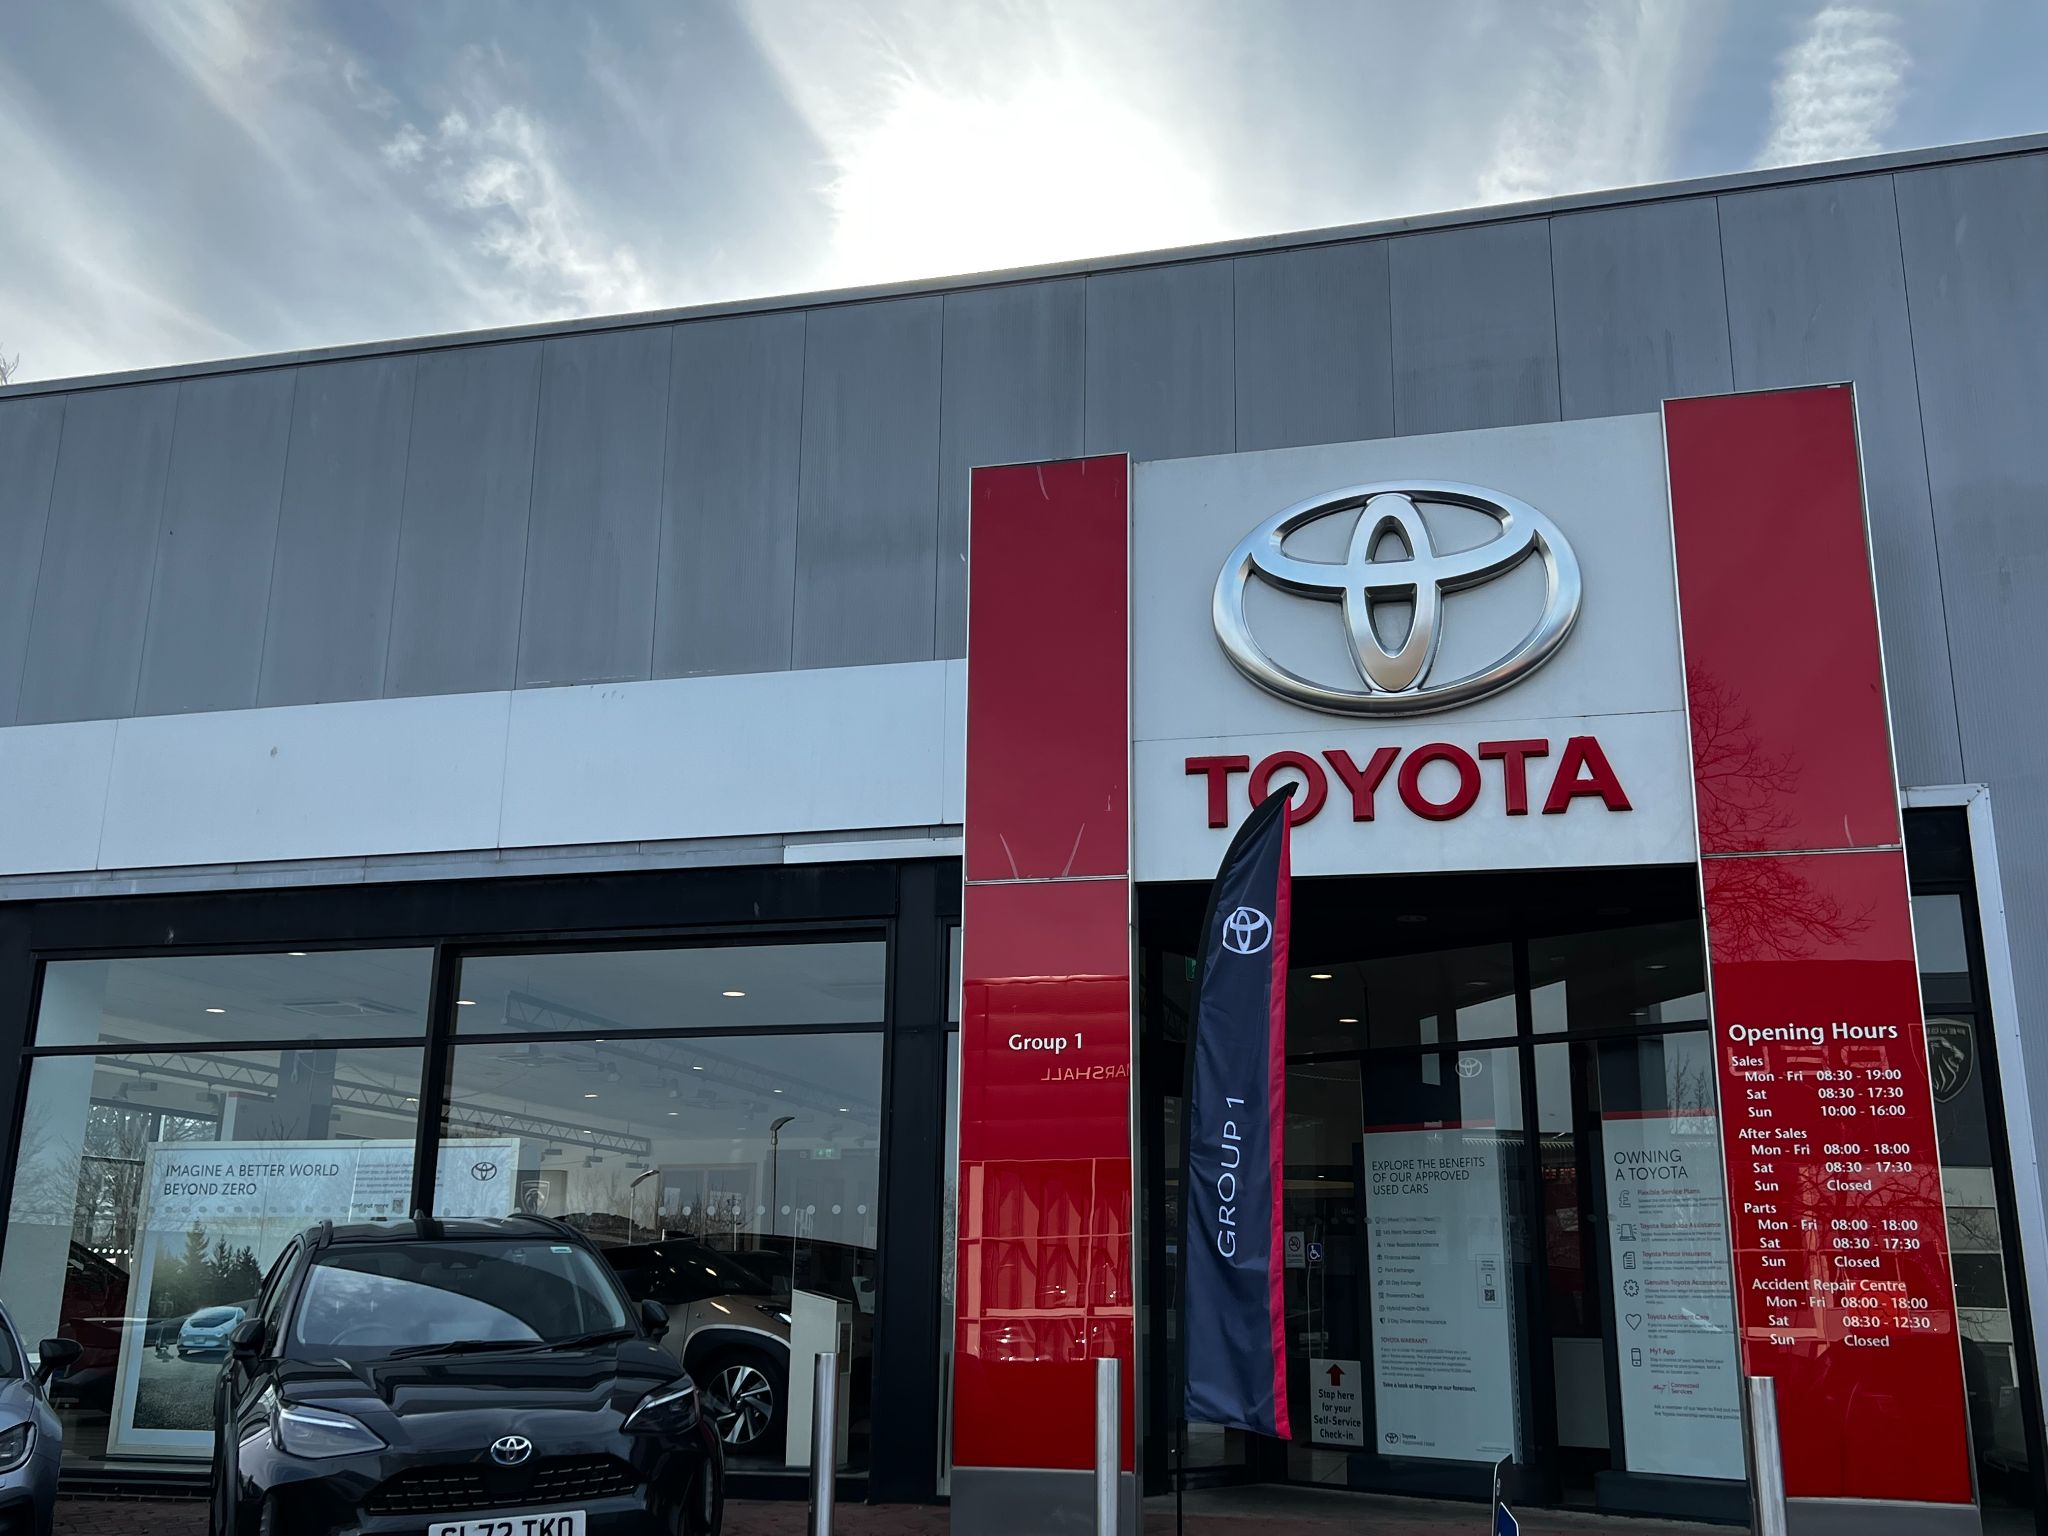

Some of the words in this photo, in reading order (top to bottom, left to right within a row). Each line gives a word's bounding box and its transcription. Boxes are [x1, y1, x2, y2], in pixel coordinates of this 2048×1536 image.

[1185, 736, 1632, 828] TOYOTA
[1728, 1023, 1825, 1045] Opening
[1832, 1023, 1898, 1039] Hours
[1008, 1034, 1067, 1054] Group
[1075, 1033, 1082, 1049] 1
[1731, 1056, 1764, 1067] Sales
[1745, 1071, 1775, 1082] Mon
[1787, 1071, 1804, 1082] Fri
[1816, 1070, 1853, 1081] 08:30
[1866, 1069, 1902, 1080] 19:00
[1746, 1089, 1767, 1100] Sat
[1818, 1088, 1855, 1099] 08:30
[1867, 1087, 1904, 1099] 17:30
[1226, 1097, 1245, 1108] 1
[1748, 1107, 1772, 1118] Sun
[1820, 1106, 1857, 1117] 10:00
[1870, 1105, 1906, 1116] 16:00
[1738, 1128, 1771, 1139] After
[1775, 1128, 1808, 1139] Sales
[1751, 1144, 1782, 1155] Mon
[1794, 1144, 1811, 1155] Fri
[1824, 1144, 1860, 1155] 08:00
[1873, 1143, 1910, 1154] 18:00
[1614, 1149, 1681, 1164] OWNING
[1372, 1160, 1414, 1170] EXPLORE
[1417, 1159, 1436, 1168] THE
[1440, 1157, 1485, 1168] BENEFITS
[1753, 1162, 1774, 1173] Sat
[1826, 1162, 1862, 1173] 08:30
[1876, 1162, 1912, 1173] 17:30
[165, 1164, 224, 1177] IMAGINE
[225, 1164, 235, 1177] A
[238, 1164, 285, 1177] BETTER
[289, 1164, 339, 1177] WORLD
[1373, 1173, 1387, 1183] OF
[1390, 1173, 1411, 1182] OUR
[1415, 1170, 1470, 1181] APPROVED
[1615, 1168, 1625, 1181] A
[1629, 1166, 1688, 1180] TOYOTA
[163, 1182, 218, 1196] BEYOND
[222, 1182, 257, 1195] ZERO
[1217, 1120, 1241, 1258] GROUP
[1373, 1185, 1399, 1195] USED
[1402, 1184, 1428, 1194] CARS
[1754, 1181, 1779, 1191] Sun
[1827, 1180, 1873, 1192] Closed
[1744, 1203, 1777, 1213] Parts
[1758, 1220, 1789, 1230] Mon
[1801, 1220, 1818, 1231] Fri
[1831, 1220, 1868, 1231] 08:00
[1881, 1220, 1919, 1231] 18:00
[1760, 1238, 1781, 1249] Sat
[1833, 1238, 1870, 1249] 08:30
[1883, 1238, 1920, 1249] 17:30
[1761, 1256, 1786, 1267] Sun
[1834, 1256, 1881, 1268] Closed
[1752, 1279, 1810, 1290] Accident
[1814, 1279, 1856, 1293] Repair
[1860, 1280, 1907, 1291] Centre
[1766, 1297, 1798, 1307] Mon
[1809, 1297, 1826, 1308] Fri
[1840, 1298, 1878, 1308] 08:00
[1891, 1298, 1928, 1309] 18:00
[1768, 1315, 1790, 1326] Sat
[1842, 1316, 1880, 1328] 08:30
[1893, 1317, 1931, 1328] 12:30
[1770, 1334, 1795, 1345] Sun
[1844, 1335, 1890, 1347] Closed
[1318, 1389, 1335, 1400] Stop
[1337, 1390, 1354, 1400] here
[1322, 1402, 1333, 1412] for
[1334, 1405, 1352, 1414] your
[1314, 1415, 1361, 1427] Self-Service
